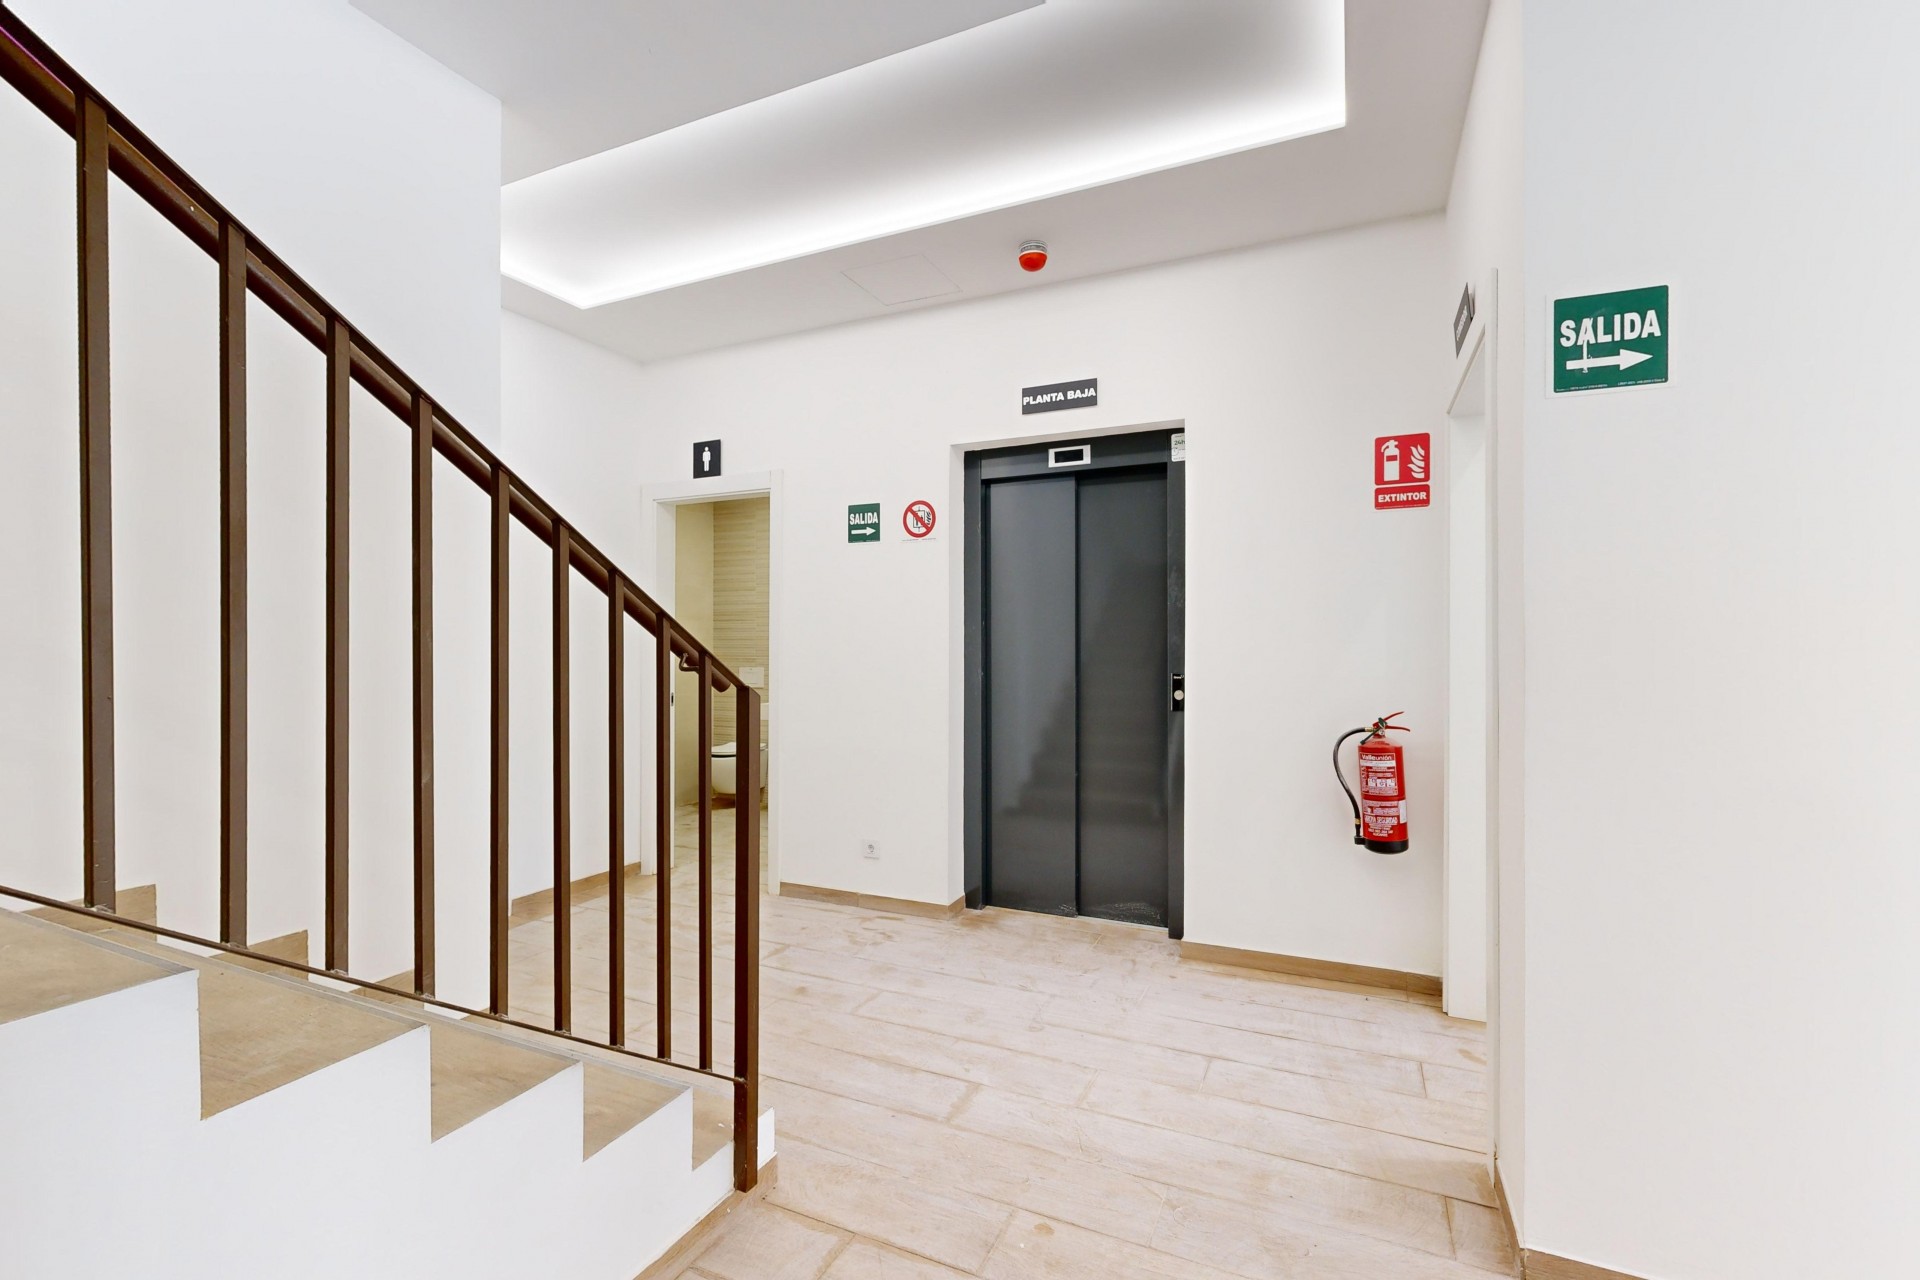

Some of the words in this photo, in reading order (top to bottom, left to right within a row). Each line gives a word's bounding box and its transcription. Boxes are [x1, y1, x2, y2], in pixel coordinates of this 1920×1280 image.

[1560, 309, 1662, 347] SALIDA
[1023, 391, 1064, 406] PLANTA
[1067, 388, 1096, 400] BAJA
[1378, 491, 1427, 503] EXTINTOR
[849, 512, 878, 525] SALIDA
